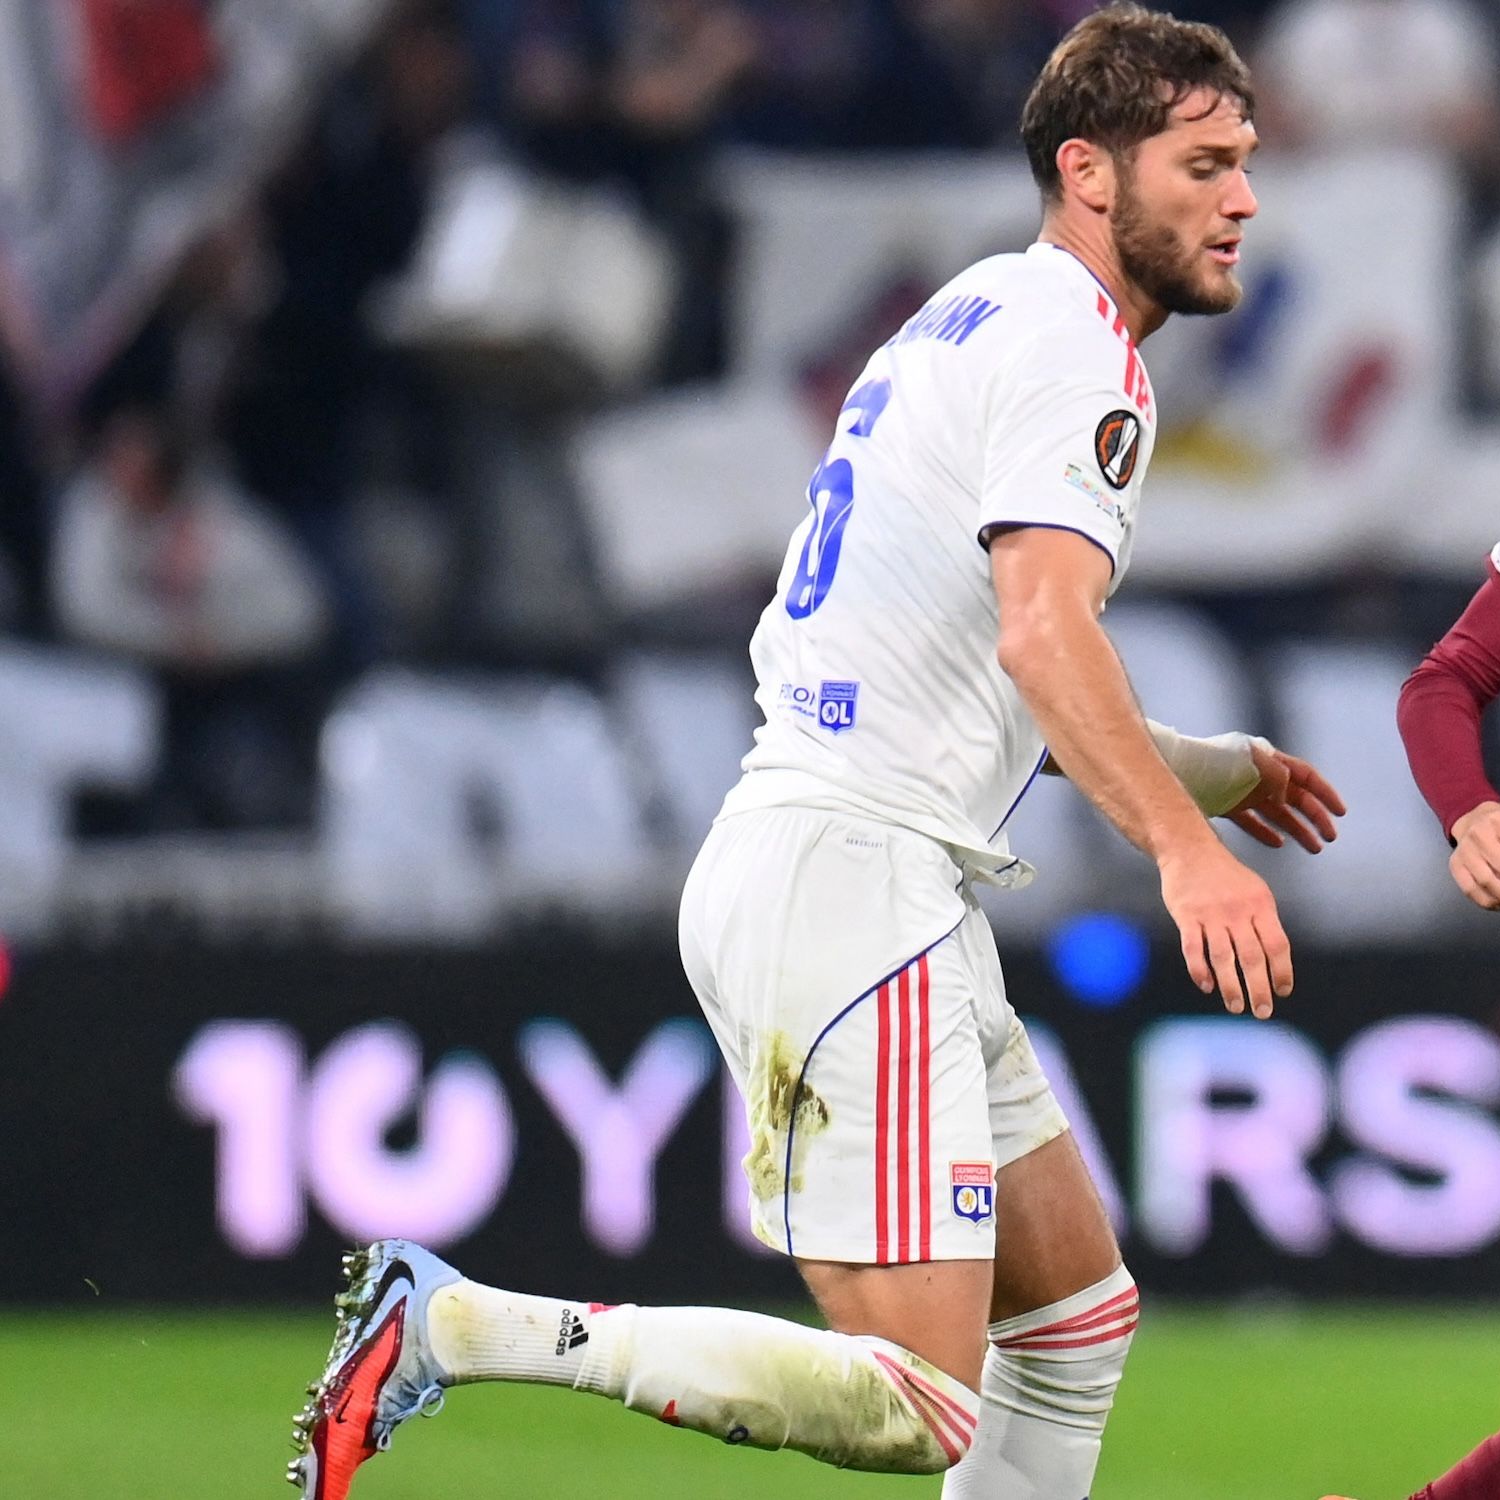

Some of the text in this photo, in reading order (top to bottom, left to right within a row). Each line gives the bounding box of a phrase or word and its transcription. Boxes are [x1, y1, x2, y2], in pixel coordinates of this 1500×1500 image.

[785, 376, 893, 621] 6
[821, 701, 852, 725] OL
[173, 1017, 516, 1262] 10
[956, 1186, 990, 1214] OL
[555, 1308, 576, 1356] adidas
